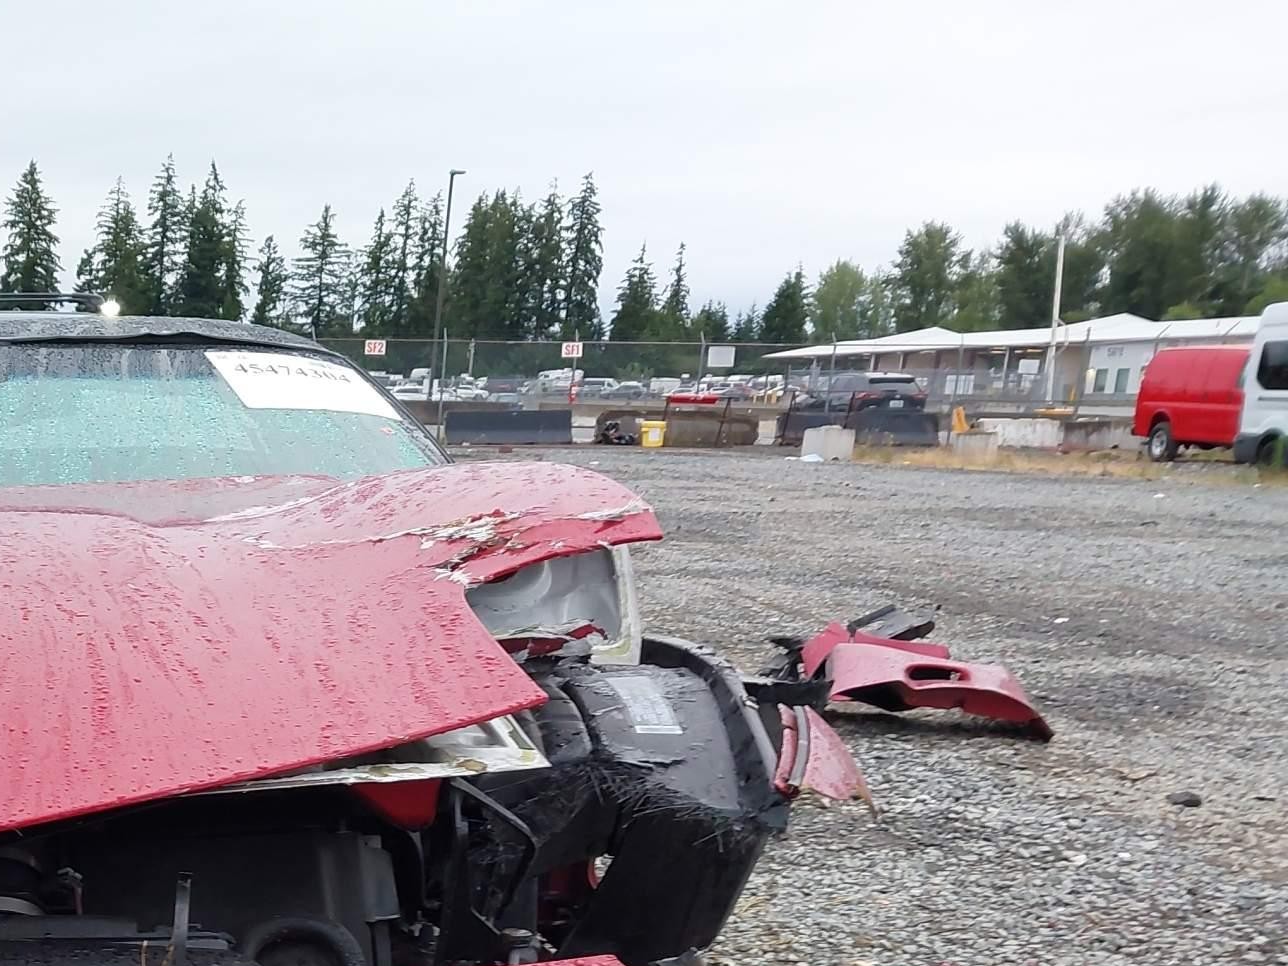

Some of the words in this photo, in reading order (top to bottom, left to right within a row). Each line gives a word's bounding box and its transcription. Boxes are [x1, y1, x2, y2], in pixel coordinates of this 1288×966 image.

[366, 341, 384, 354] SF2
[564, 343, 580, 356] SF1
[233, 362, 352, 384] 45474304
